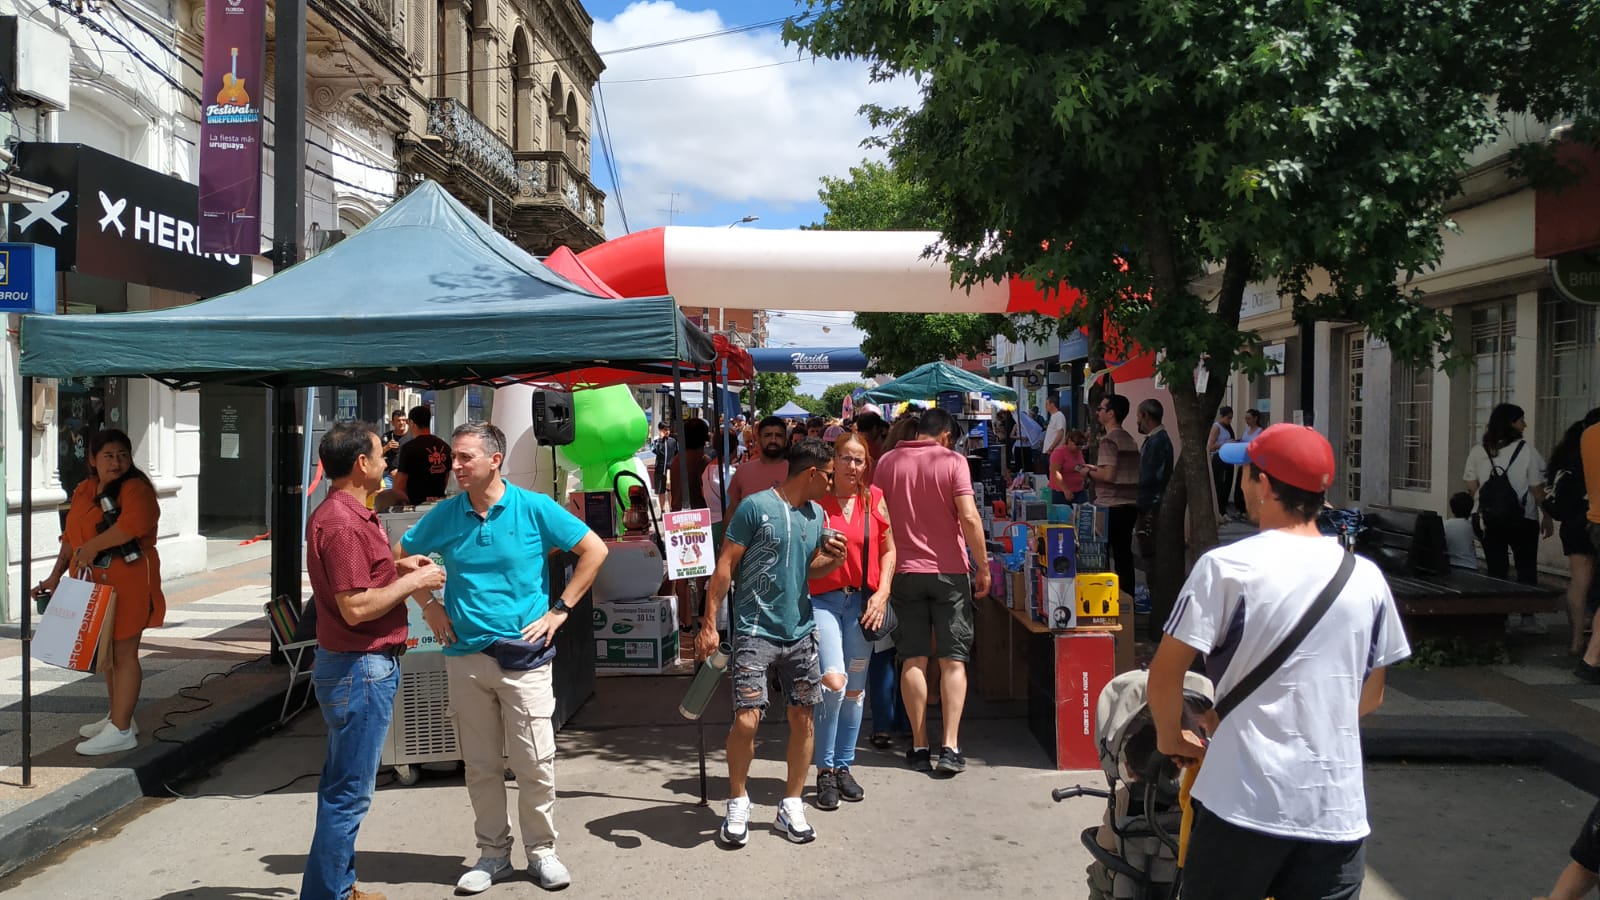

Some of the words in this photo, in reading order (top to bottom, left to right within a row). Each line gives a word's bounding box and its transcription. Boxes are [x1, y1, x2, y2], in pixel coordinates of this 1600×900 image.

[206, 103, 250, 117] Festival
[207, 114, 259, 124] INDEPENDENCIA
[219, 134, 239, 142] fiesta
[134, 206, 240, 266] HERI
[0, 291, 29, 301] BROU
[791, 352, 829, 364] Florida
[81, 583, 101, 632] ONLINE
[68, 633, 84, 670] SHOP
